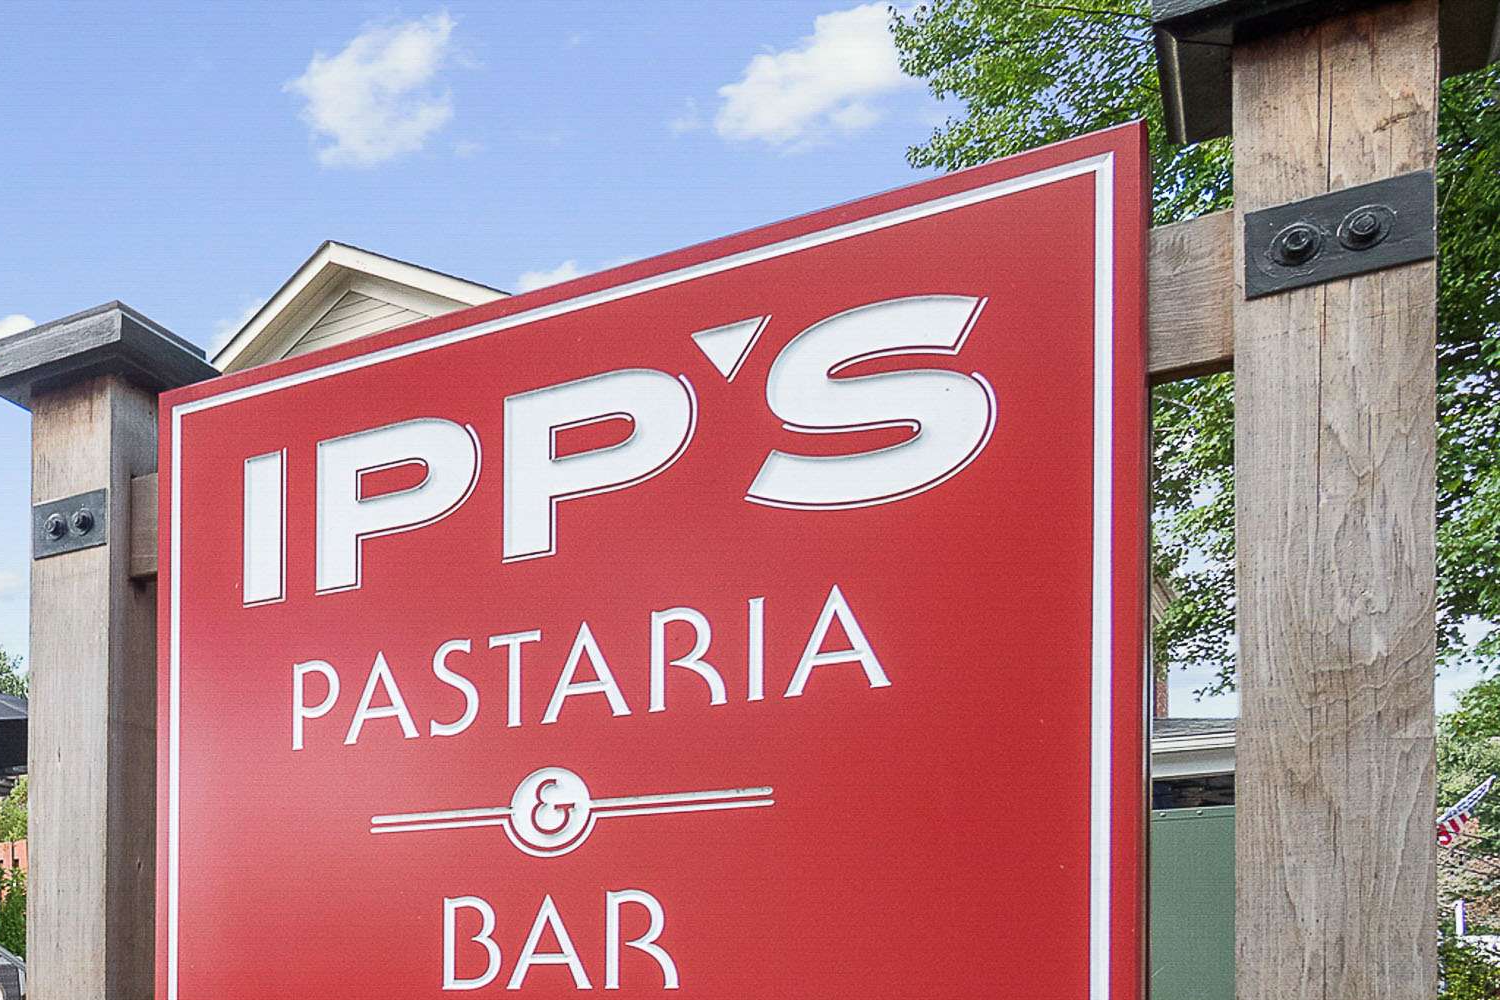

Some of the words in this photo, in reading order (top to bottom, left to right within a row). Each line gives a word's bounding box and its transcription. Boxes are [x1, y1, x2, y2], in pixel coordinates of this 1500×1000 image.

[242, 293, 998, 609] IPP'S
[291, 584, 892, 751] PASTARIA
[529, 776, 577, 837] &
[442, 889, 680, 990] BAR
